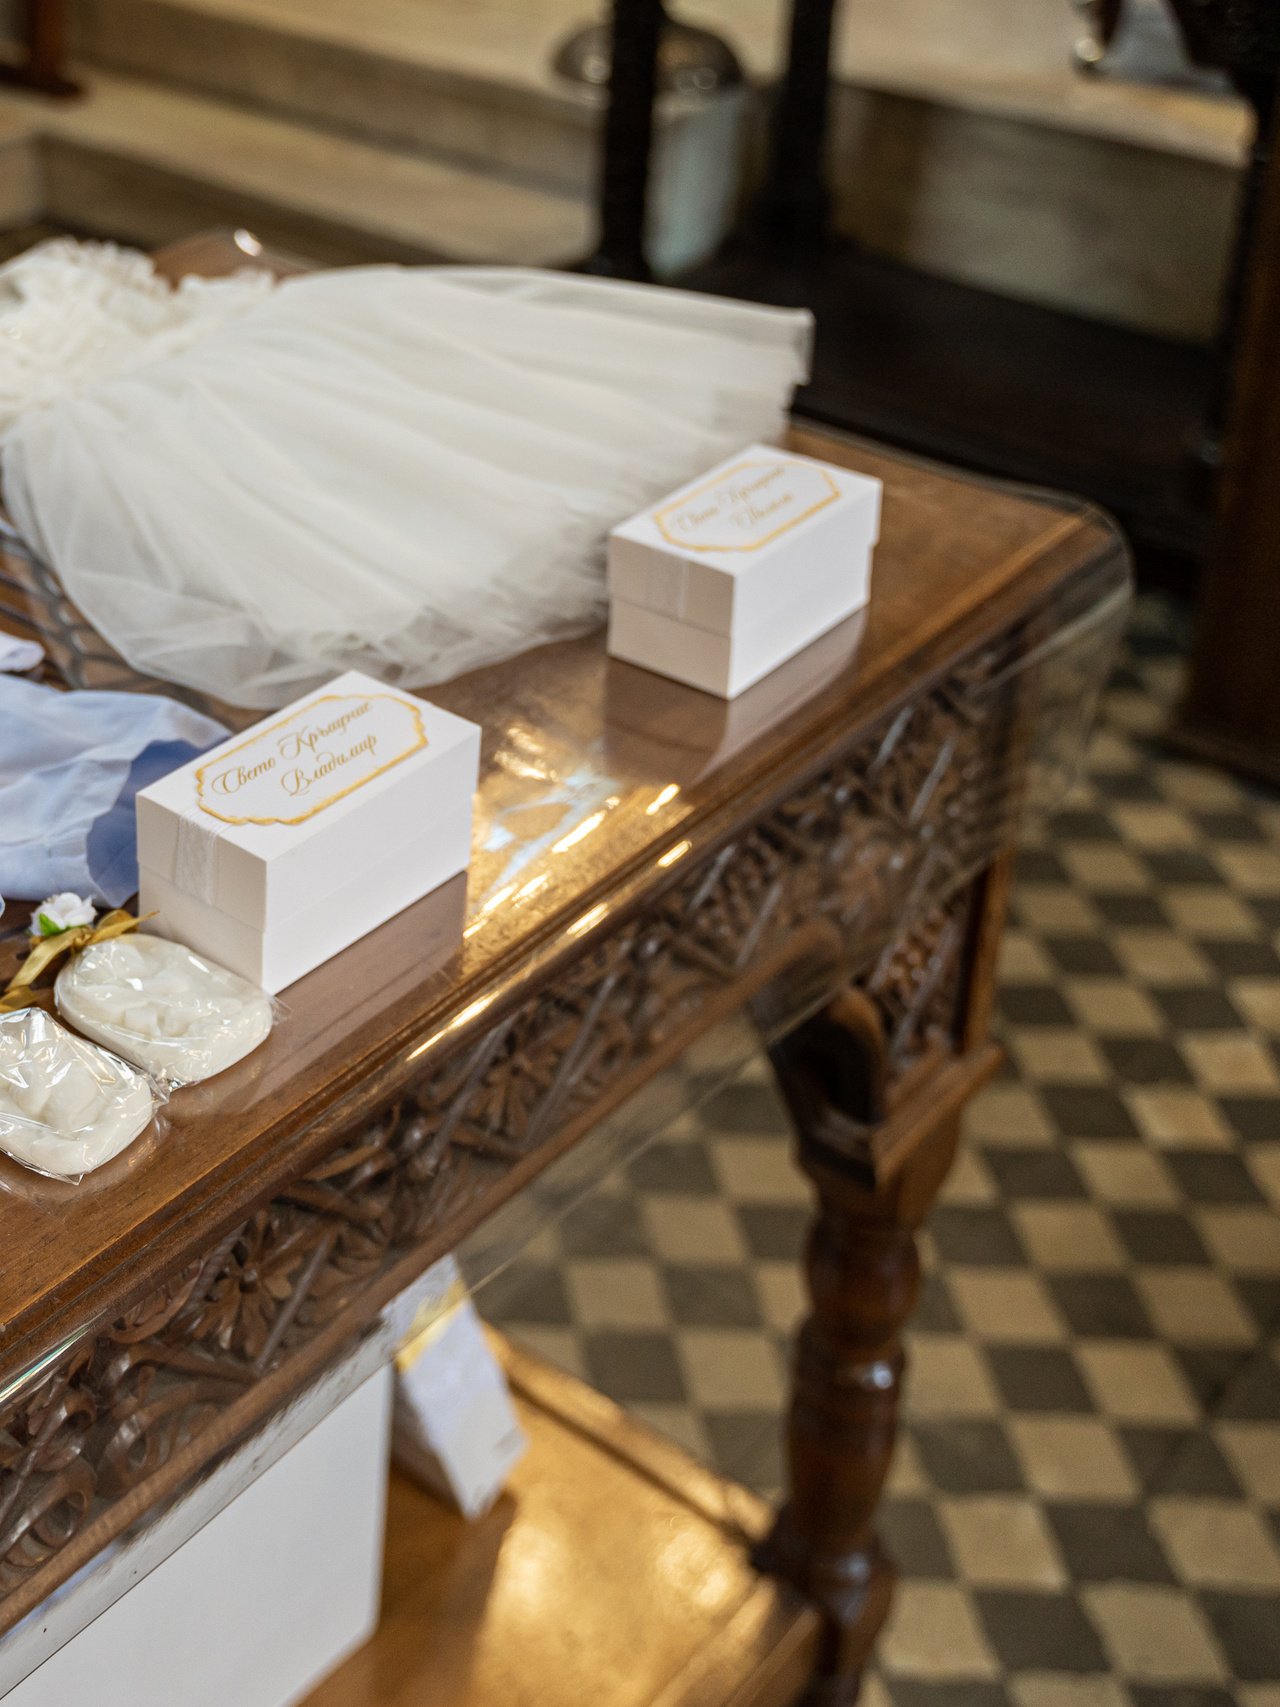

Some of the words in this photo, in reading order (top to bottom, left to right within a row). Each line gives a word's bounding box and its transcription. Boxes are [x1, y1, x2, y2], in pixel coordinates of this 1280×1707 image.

[211, 757, 277, 795] Свето
[276, 701, 374, 761] Кръщение
[280, 733, 377, 798] Владимир
